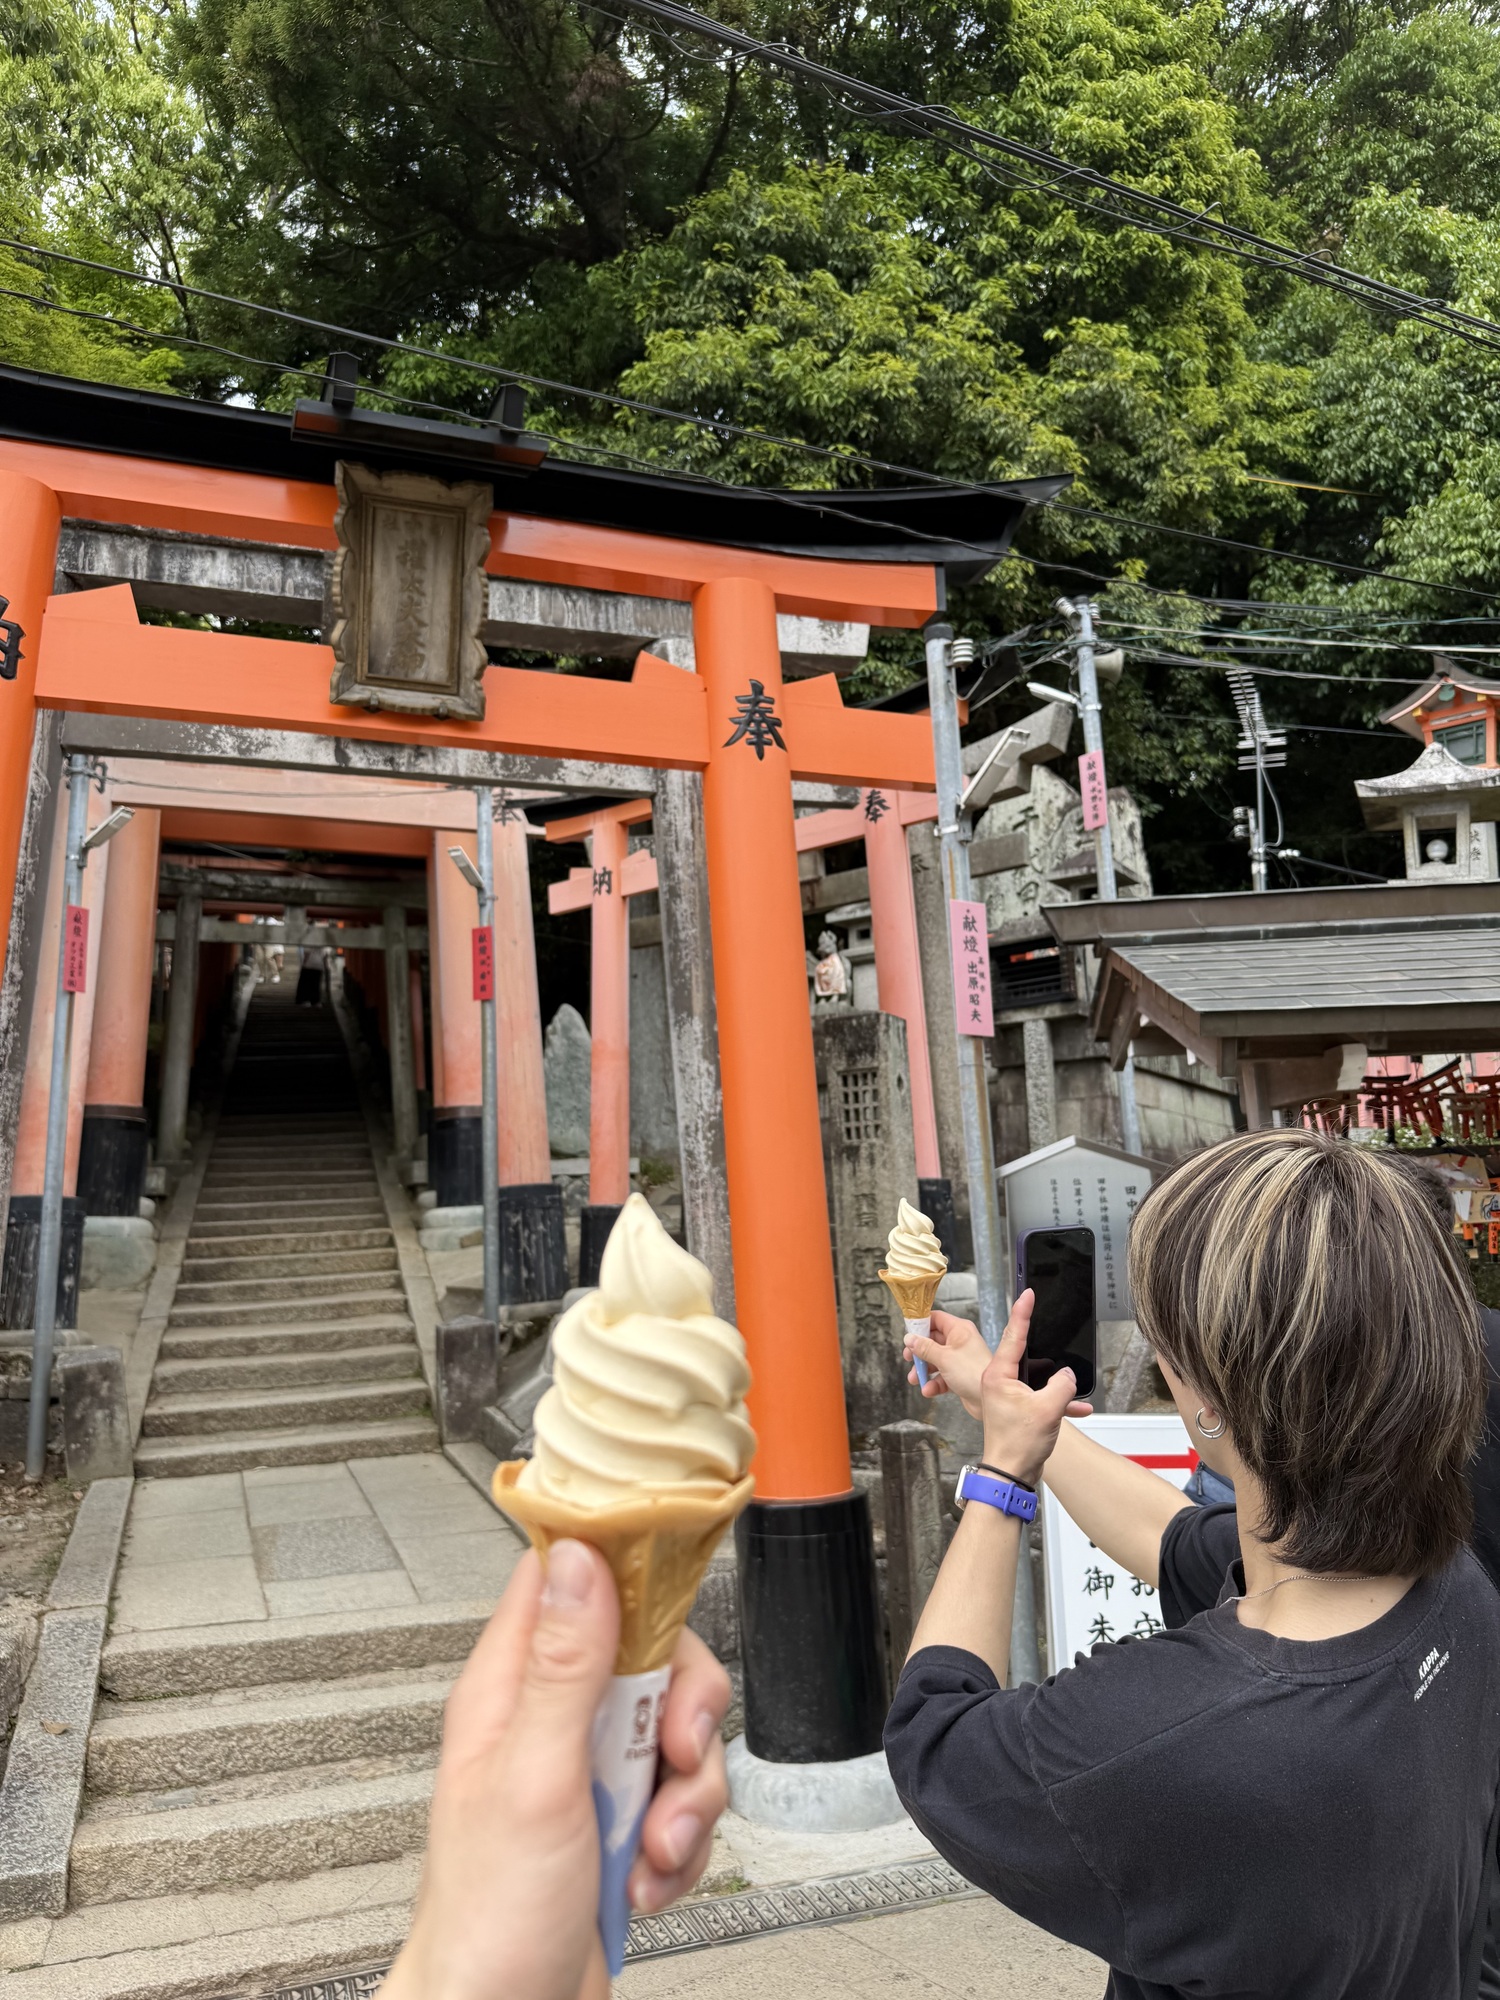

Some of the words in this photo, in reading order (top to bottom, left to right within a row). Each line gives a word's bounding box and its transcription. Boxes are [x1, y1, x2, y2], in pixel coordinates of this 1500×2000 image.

[721, 678, 788, 761] 奉
[865, 789, 891, 824] 奉
[593, 866, 613, 896] 納
[963, 914, 979, 953] 献燈
[968, 961, 983, 1023] 出原昭夫
[1082, 1566, 1116, 1646] 御朱
[1418, 1647, 1440, 1681] KAPPA
